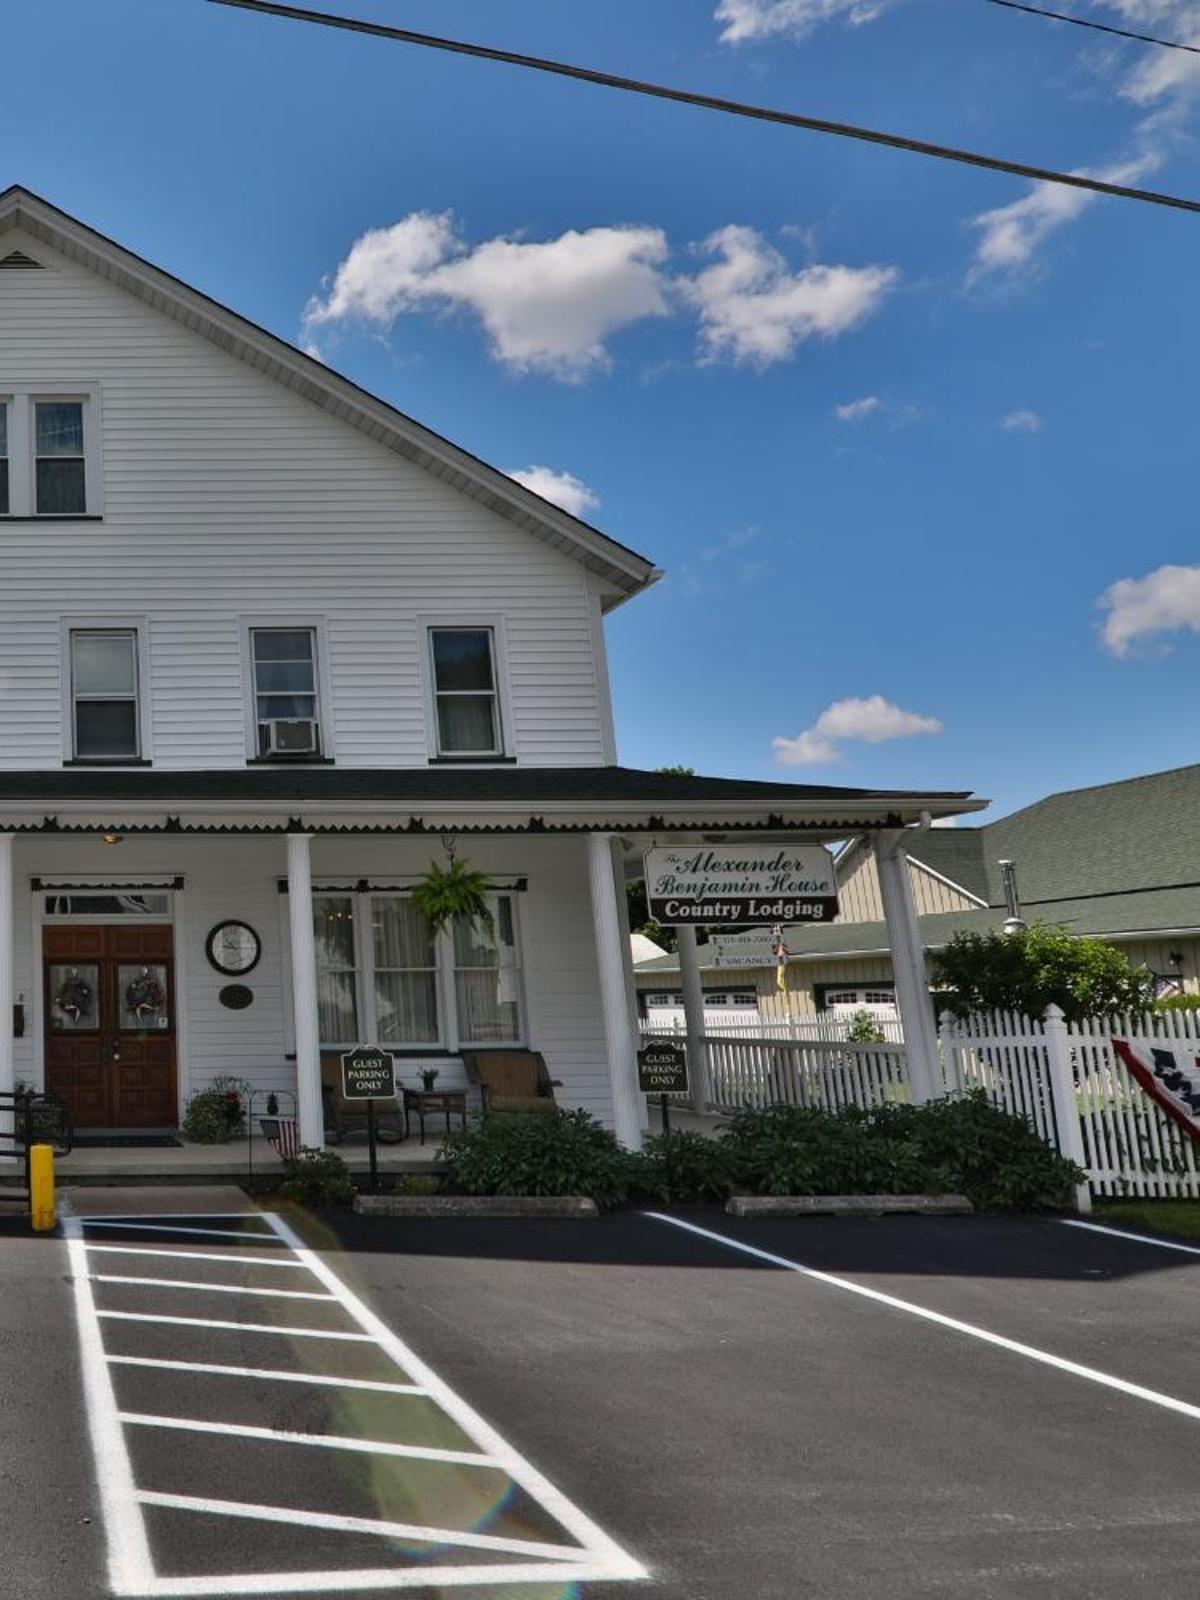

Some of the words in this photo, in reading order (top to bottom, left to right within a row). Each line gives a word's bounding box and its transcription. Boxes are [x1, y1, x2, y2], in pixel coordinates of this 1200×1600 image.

[676, 851, 803, 874] Alexander
[655, 874, 761, 902] Benjamin
[765, 873, 829, 893] House
[665, 901, 741, 919] Country
[748, 900, 824, 919] Lodging
[645, 1054, 676, 1063] GUEST
[352, 1059, 383, 1068] GUEST
[641, 1065, 683, 1074] PARKING
[348, 1070, 390, 1080] PARKING
[650, 1076, 676, 1085] ONLY
[356, 1081, 383, 1090] ONLY
